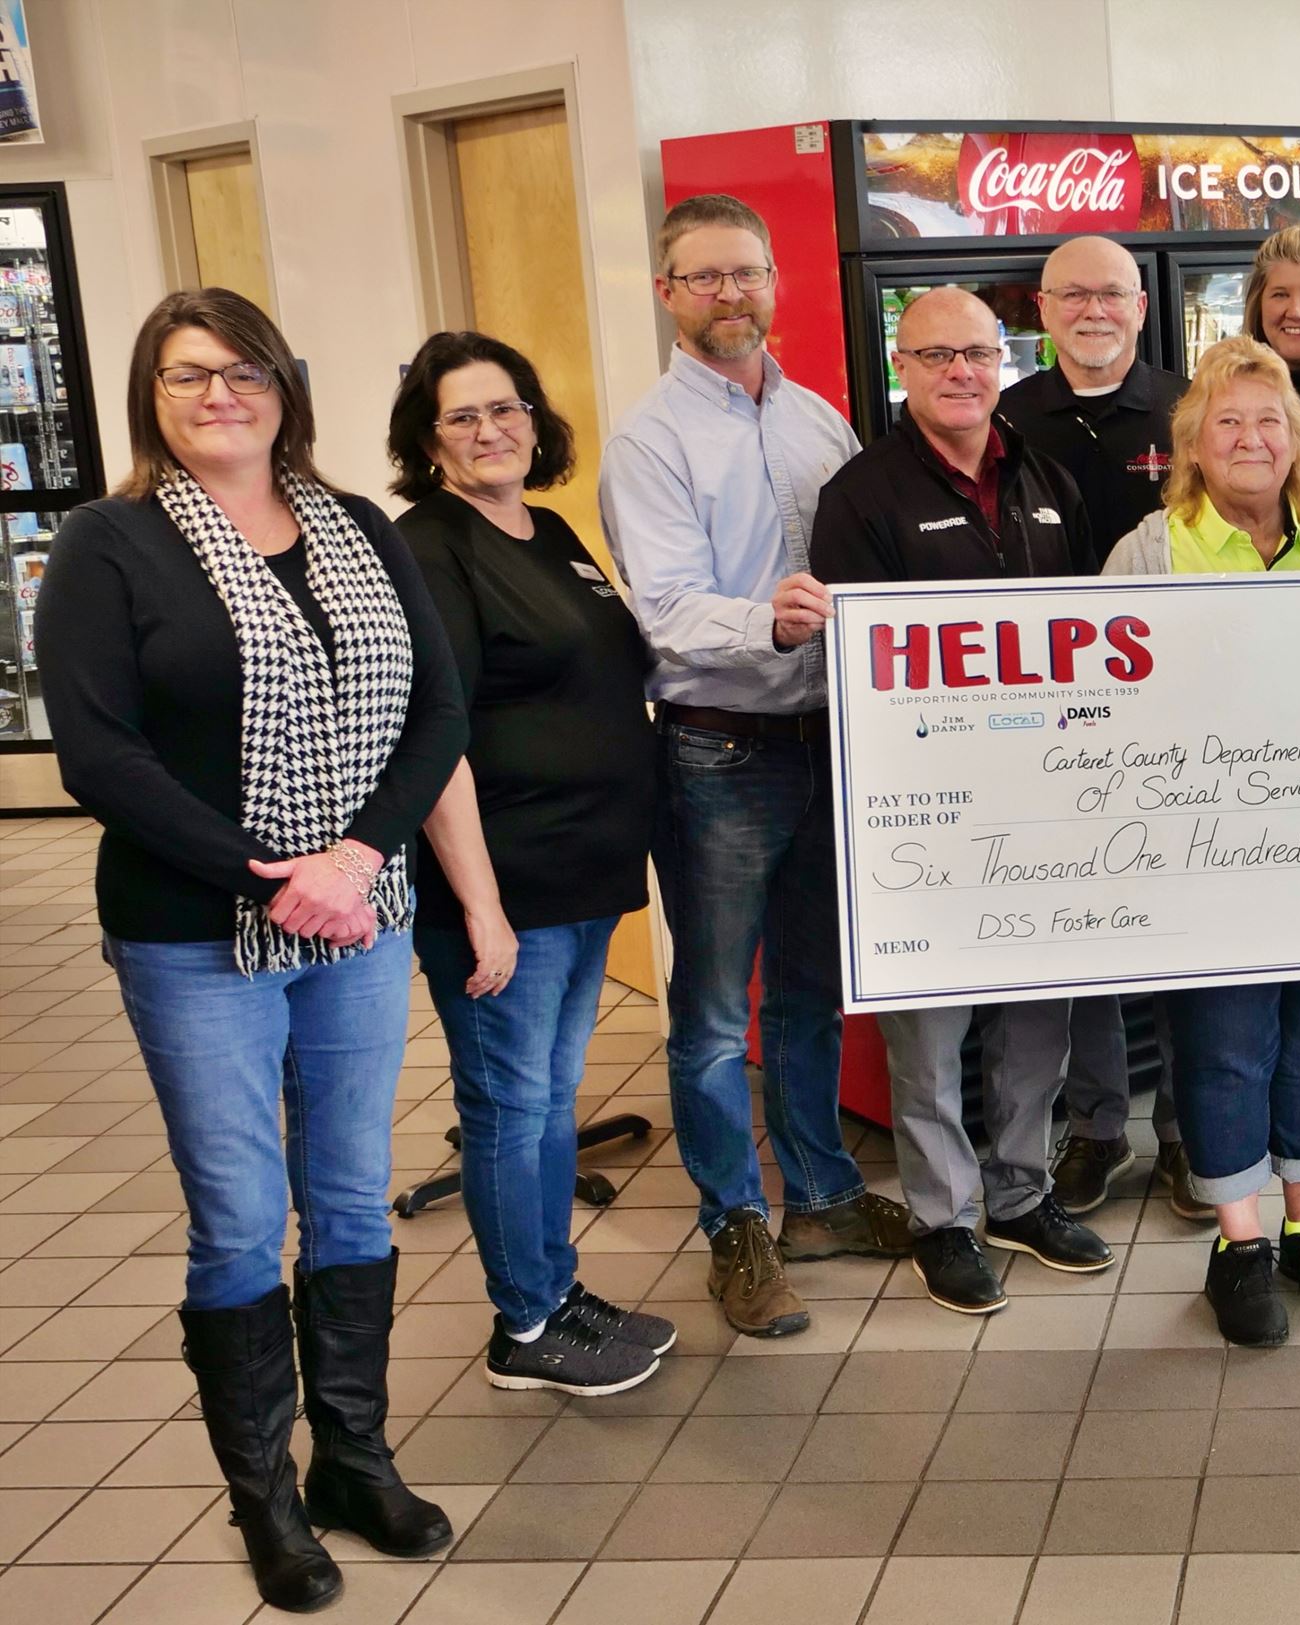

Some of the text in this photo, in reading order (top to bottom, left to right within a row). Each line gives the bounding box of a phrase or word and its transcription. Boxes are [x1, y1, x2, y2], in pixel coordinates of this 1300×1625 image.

[968, 147, 1132, 213] Coca-Cola
[1158, 164, 1224, 200] ICE
[919, 516, 968, 532] POWERADE
[870, 615, 1153, 691] HELPS
[889, 687, 1139, 706] SUPPORTING OUR COMMUNITY SINCE 1939
[992, 716, 1039, 726] LOCAL
[1067, 706, 1111, 719] DAVIS
[931, 724, 975, 734] DANDY
[1043, 746, 1113, 773] Carteret
[1121, 742, 1188, 779] County
[866, 791, 973, 809] PAY TO THE
[1136, 775, 1222, 810] Social
[866, 811, 961, 829] ORDER OF
[872, 842, 953, 891] Six
[970, 833, 1098, 886] Thousand
[1104, 820, 1167, 875] One
[976, 905, 1151, 940] DSS Foster Care
[874, 938, 930, 955] MEMO
